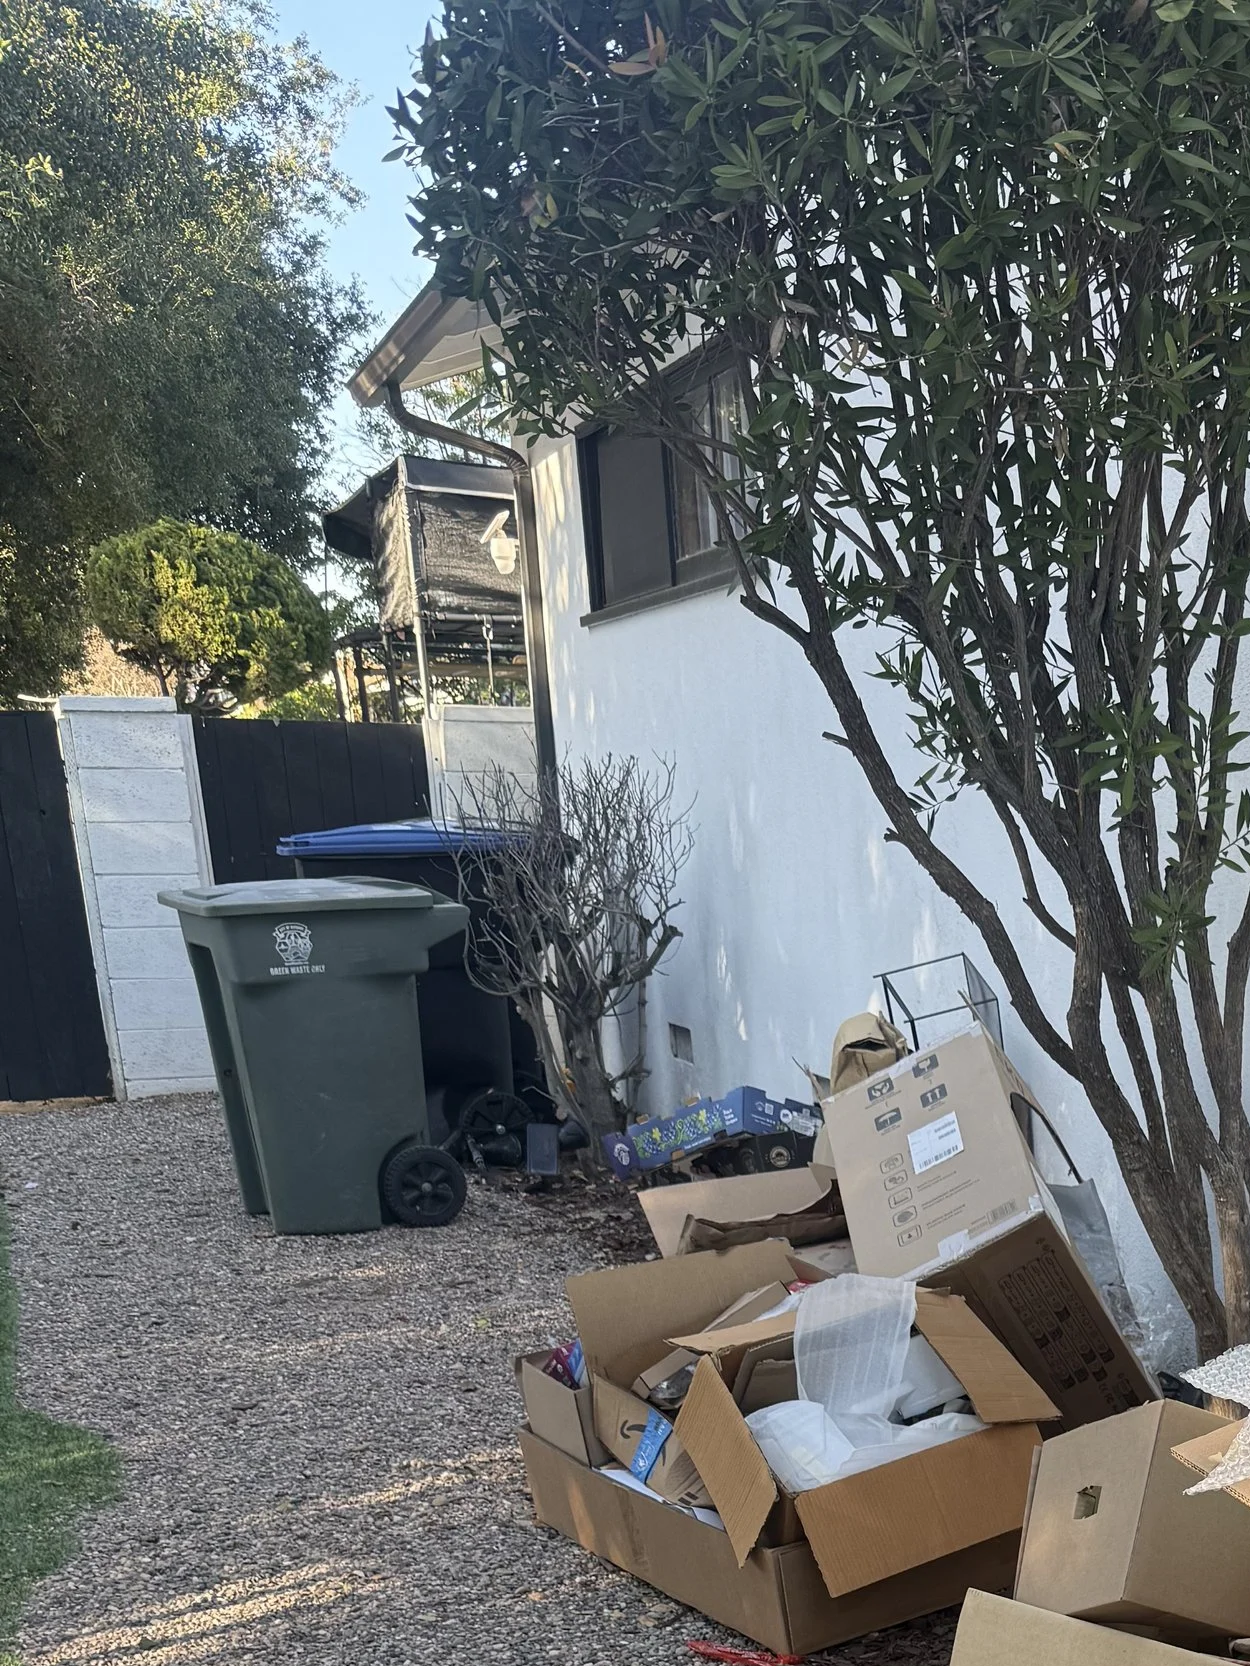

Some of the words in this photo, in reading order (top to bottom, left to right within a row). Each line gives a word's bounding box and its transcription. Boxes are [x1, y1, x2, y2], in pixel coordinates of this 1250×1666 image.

[270, 967, 290, 976] GREEN
[290, 965, 310, 974] WASTE
[311, 964, 326, 973] ONLY
